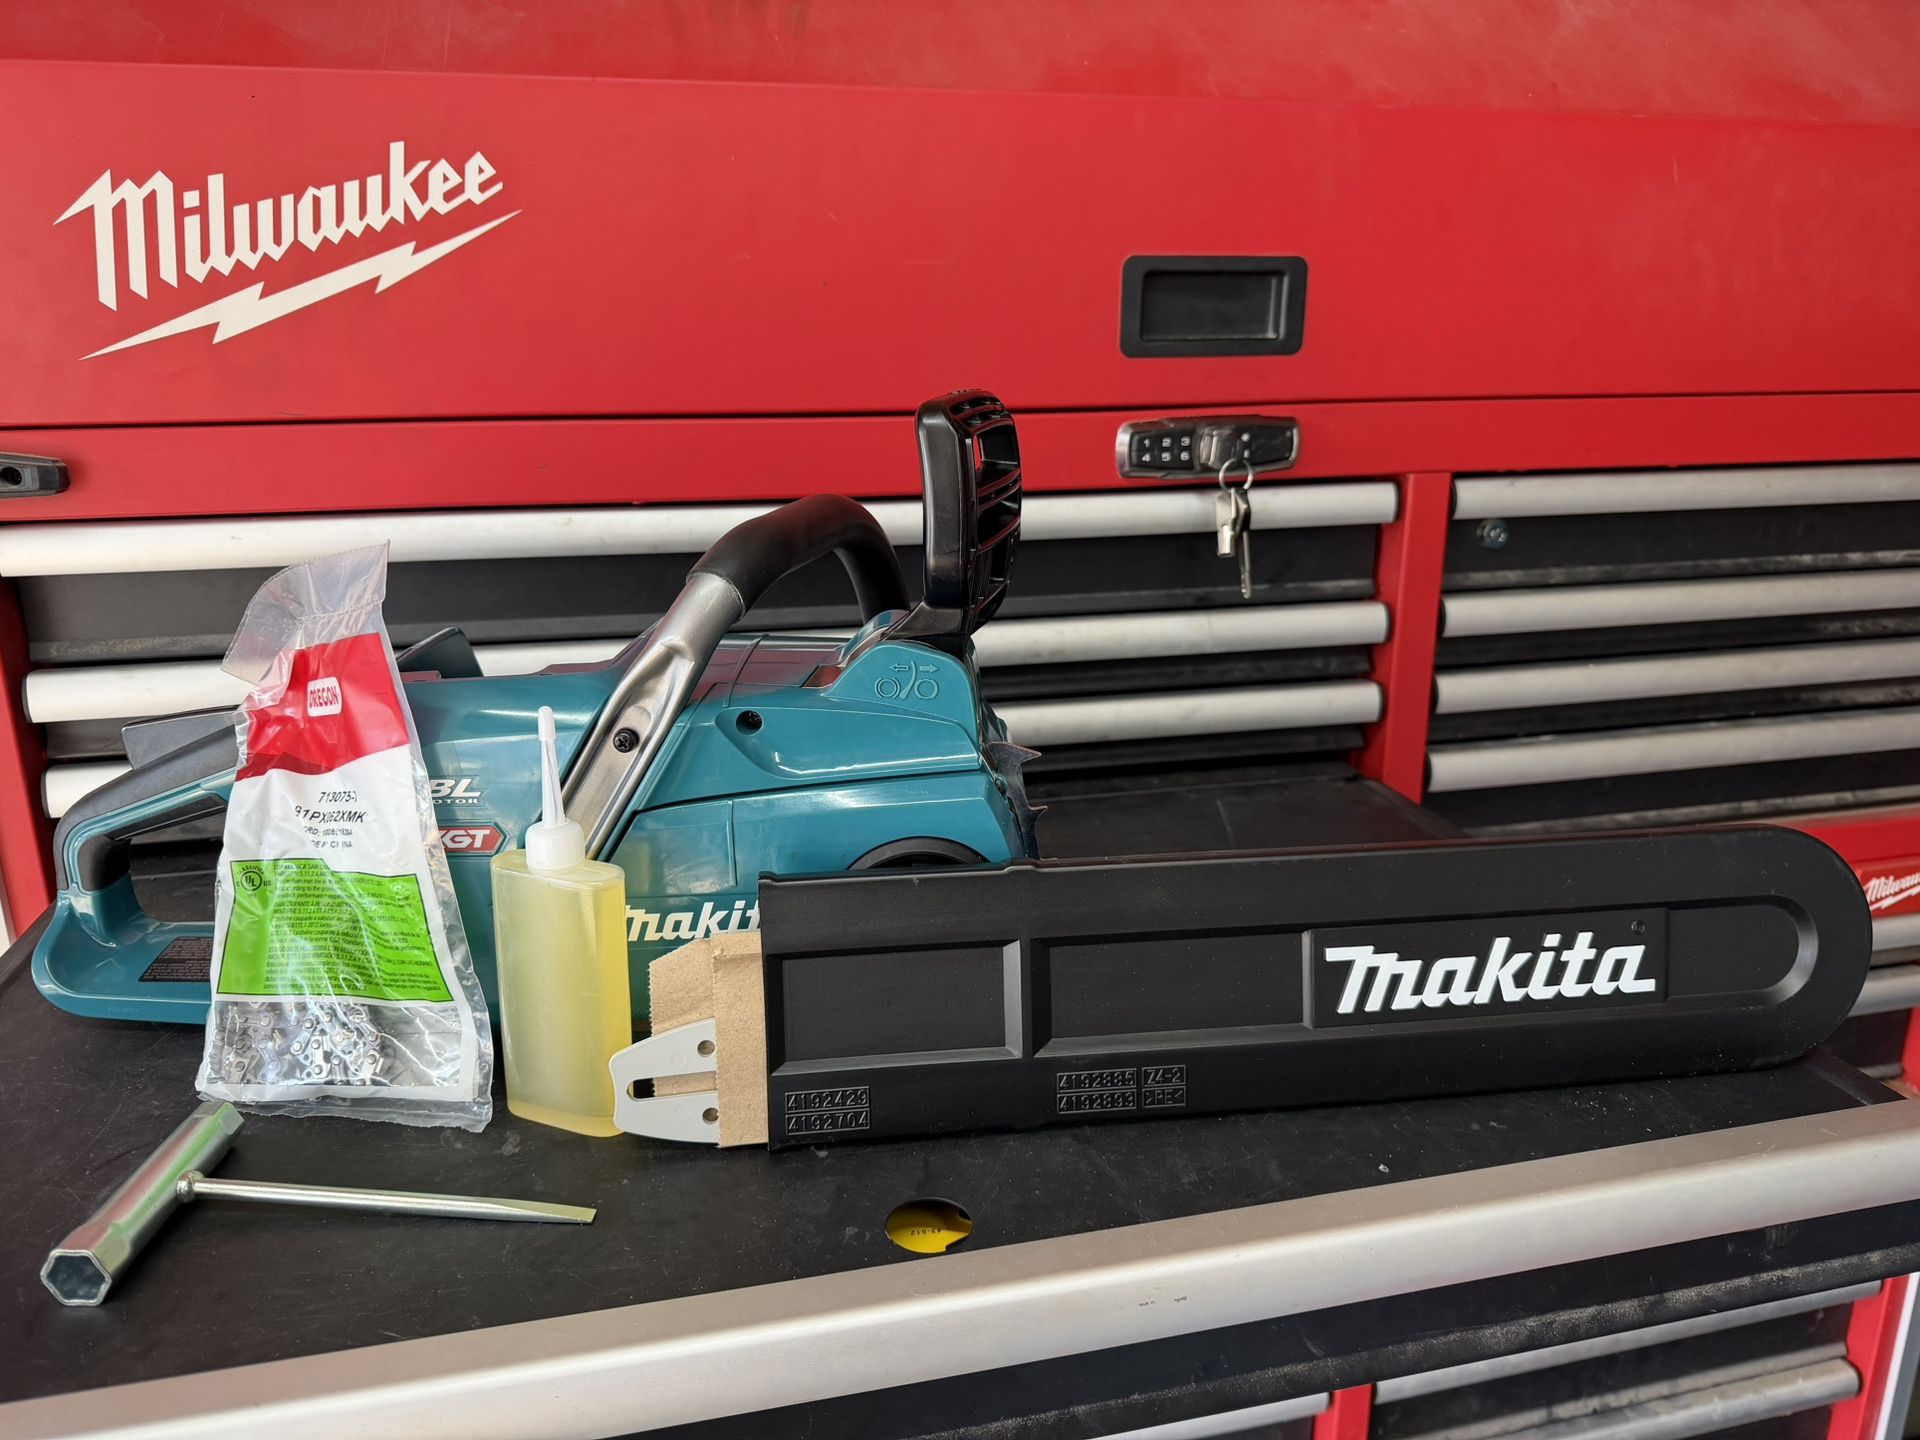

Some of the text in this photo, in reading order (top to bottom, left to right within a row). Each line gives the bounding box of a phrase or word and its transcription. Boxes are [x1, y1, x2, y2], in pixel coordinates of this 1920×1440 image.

[53, 141, 503, 311] Milwaukee
[1161, 437, 1172, 448] 2
[1181, 436, 1191, 447] 3
[1141, 451, 1190, 462] 4 5 6
[430, 779, 481, 798] BL
[625, 900, 760, 941] makit
[1060, 1070, 1134, 1089] 4192885
[787, 1089, 867, 1110] 4192429
[1060, 1092, 1134, 1111] 4192893
[788, 1111, 867, 1132] 4192704
